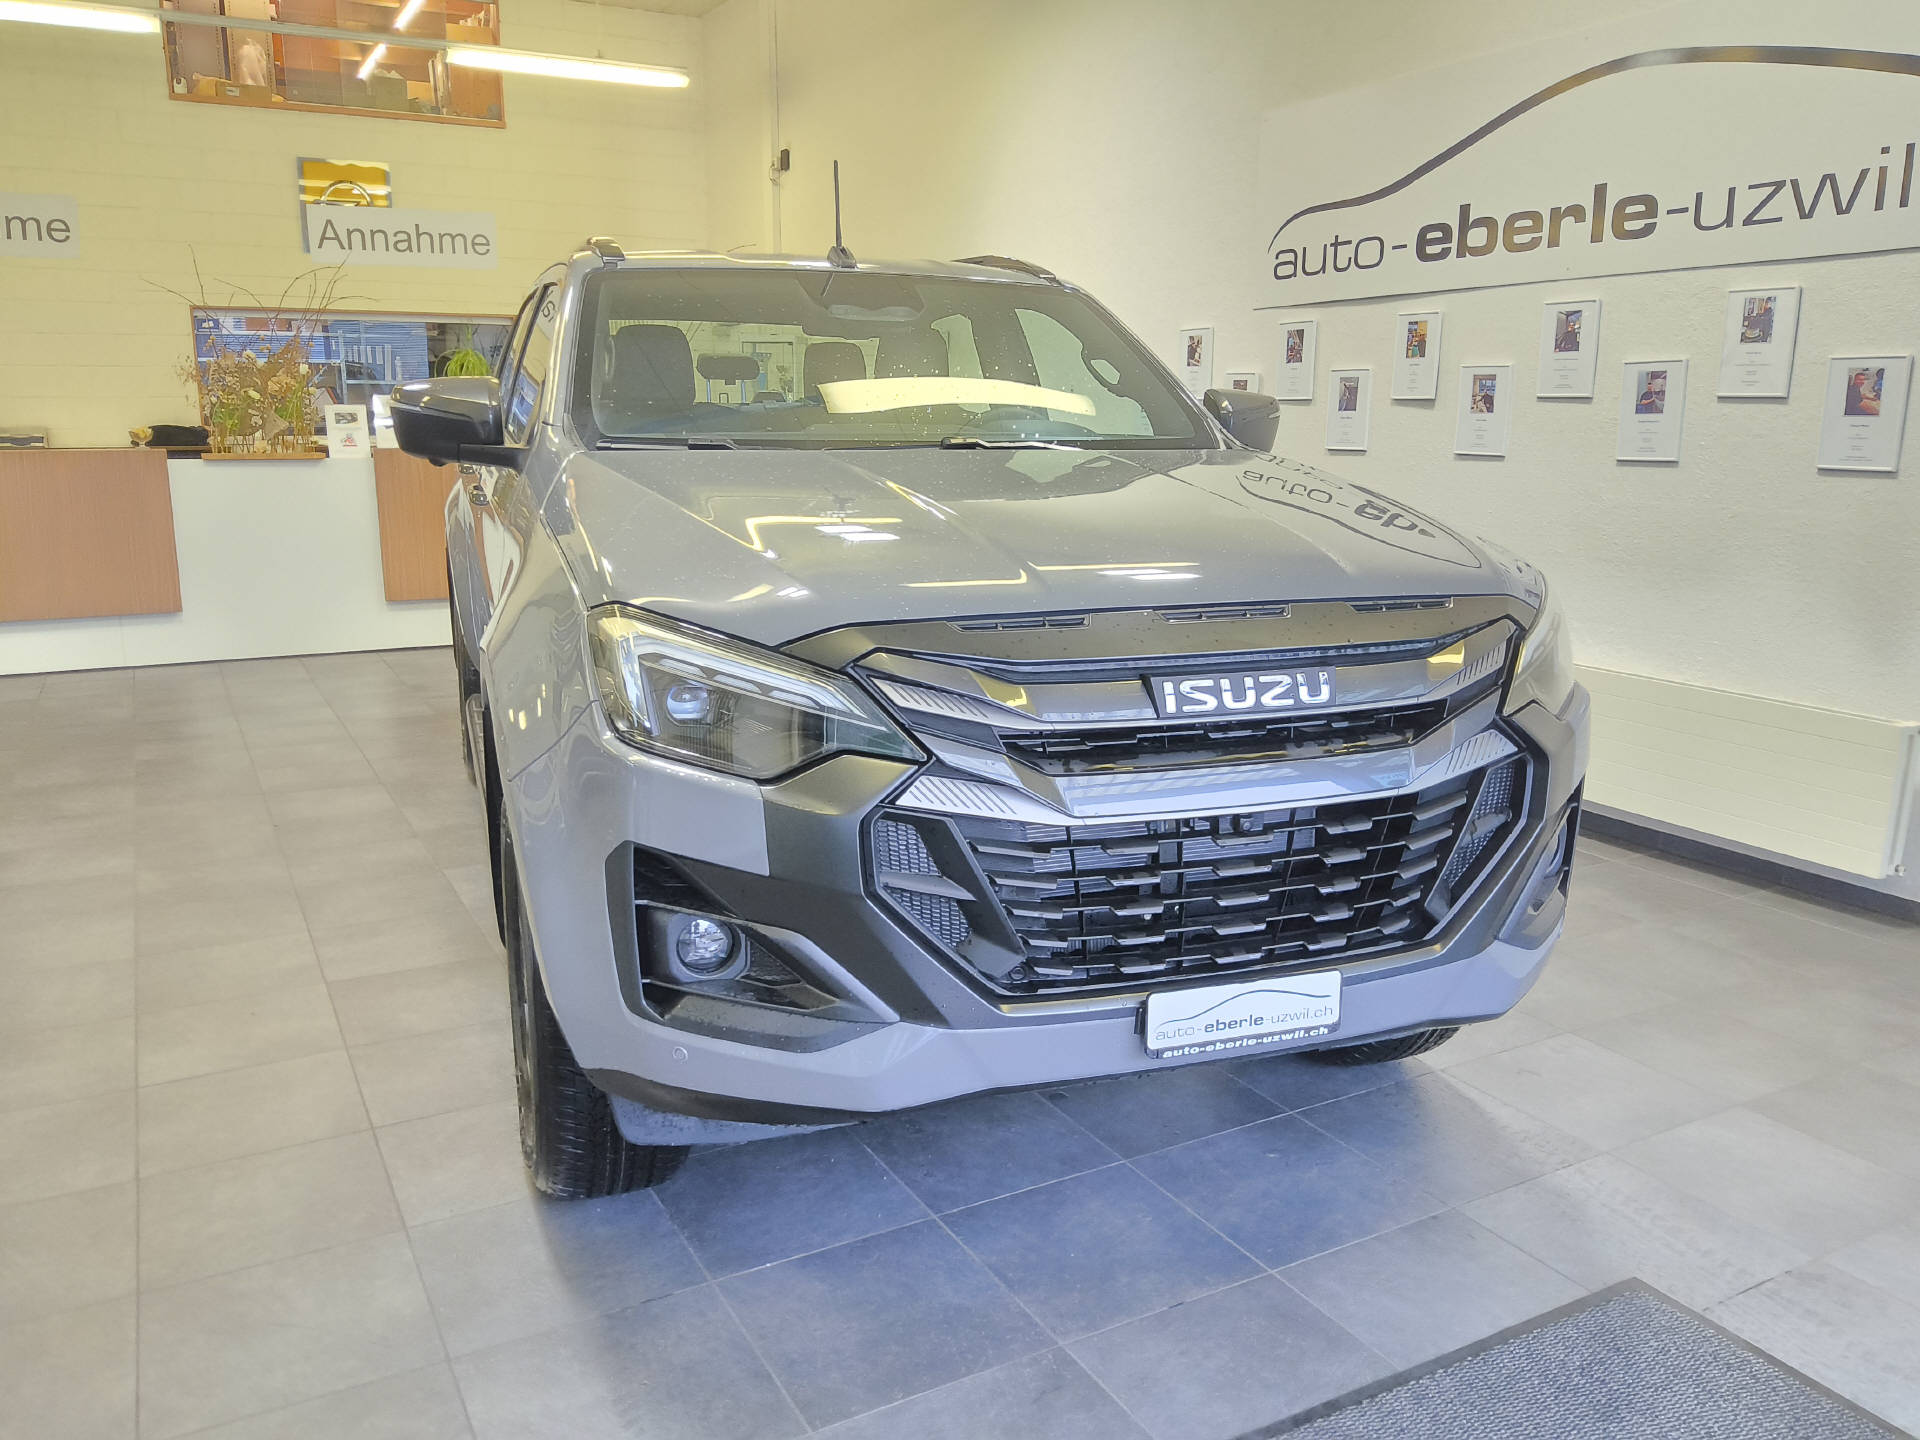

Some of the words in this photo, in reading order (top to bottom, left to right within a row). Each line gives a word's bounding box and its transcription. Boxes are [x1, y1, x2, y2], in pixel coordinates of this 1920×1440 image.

[1273, 142, 1916, 280] auto-eberle-uzwil
[317, 219, 491, 256] Annahme
[1162, 671, 1331, 714] ISUZU
[1155, 1005, 1333, 1041] auto-eberle-uzwil.ch
[1162, 1026, 1329, 1059] auto-eberle-uzwil.ch
